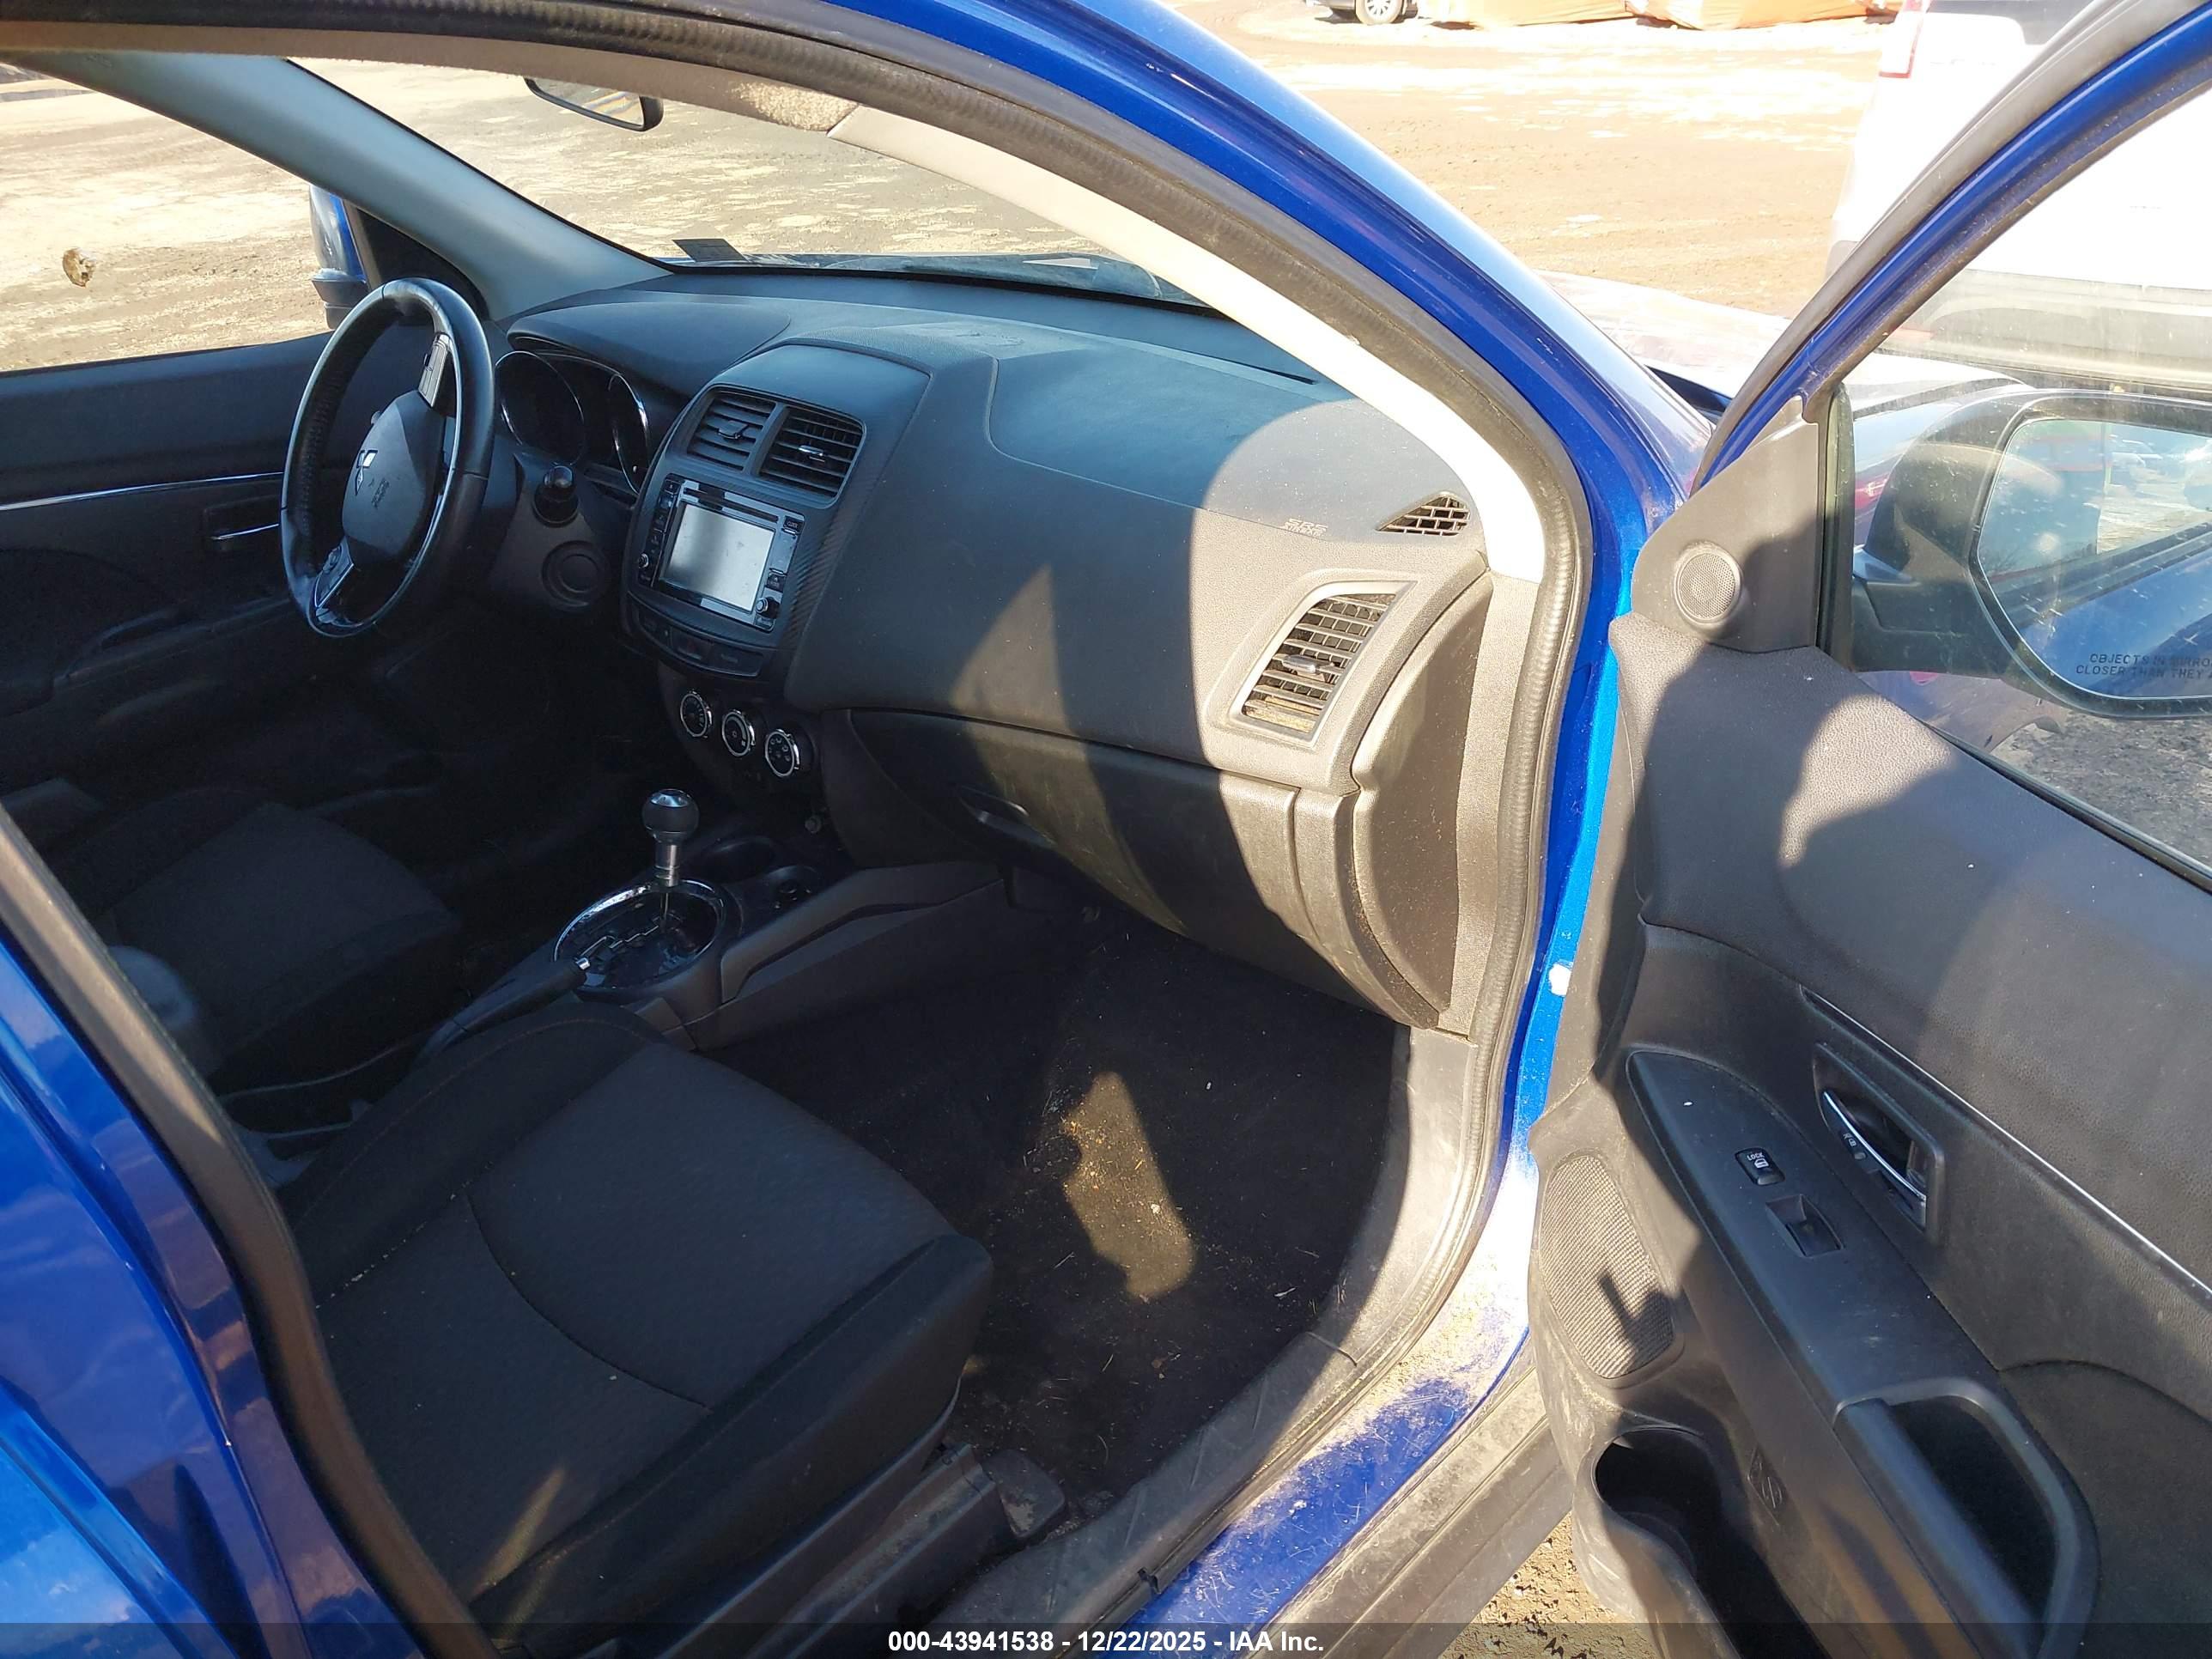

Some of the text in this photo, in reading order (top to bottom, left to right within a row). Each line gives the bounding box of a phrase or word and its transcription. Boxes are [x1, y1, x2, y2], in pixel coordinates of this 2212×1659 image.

[1288, 518, 1328, 532] SRS
[2089, 653, 2149, 665] OBJECTS
[2171, 655, 2212, 668] MIRRO
[2075, 665, 2125, 676] CLOSER
[2129, 666, 2164, 678] THAN
[2172, 668, 2205, 679] THEY
[1747, 1152, 1765, 1161] LOCK
